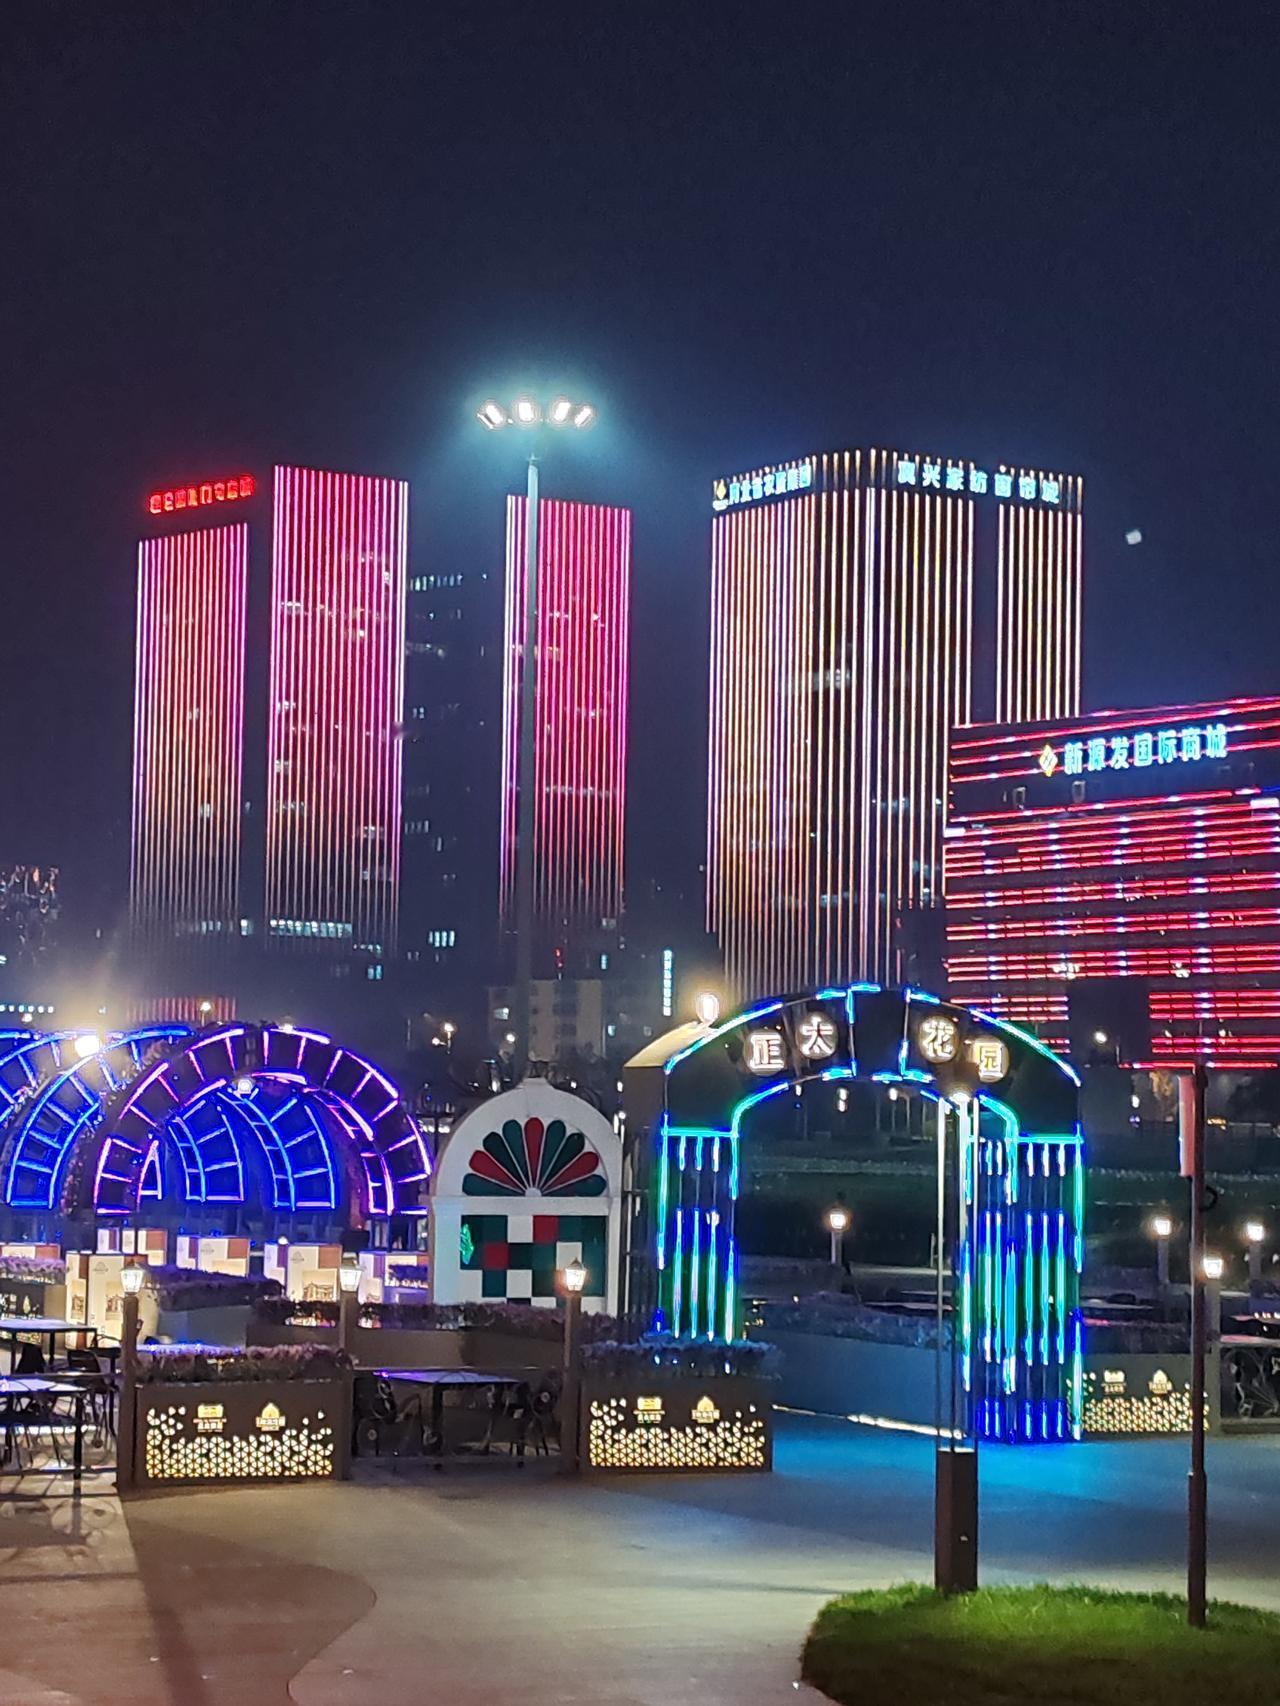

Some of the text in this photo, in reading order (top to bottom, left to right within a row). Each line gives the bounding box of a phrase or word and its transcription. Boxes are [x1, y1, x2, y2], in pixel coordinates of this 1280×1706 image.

[1064, 723, 1227, 775] 新源发国际商城
